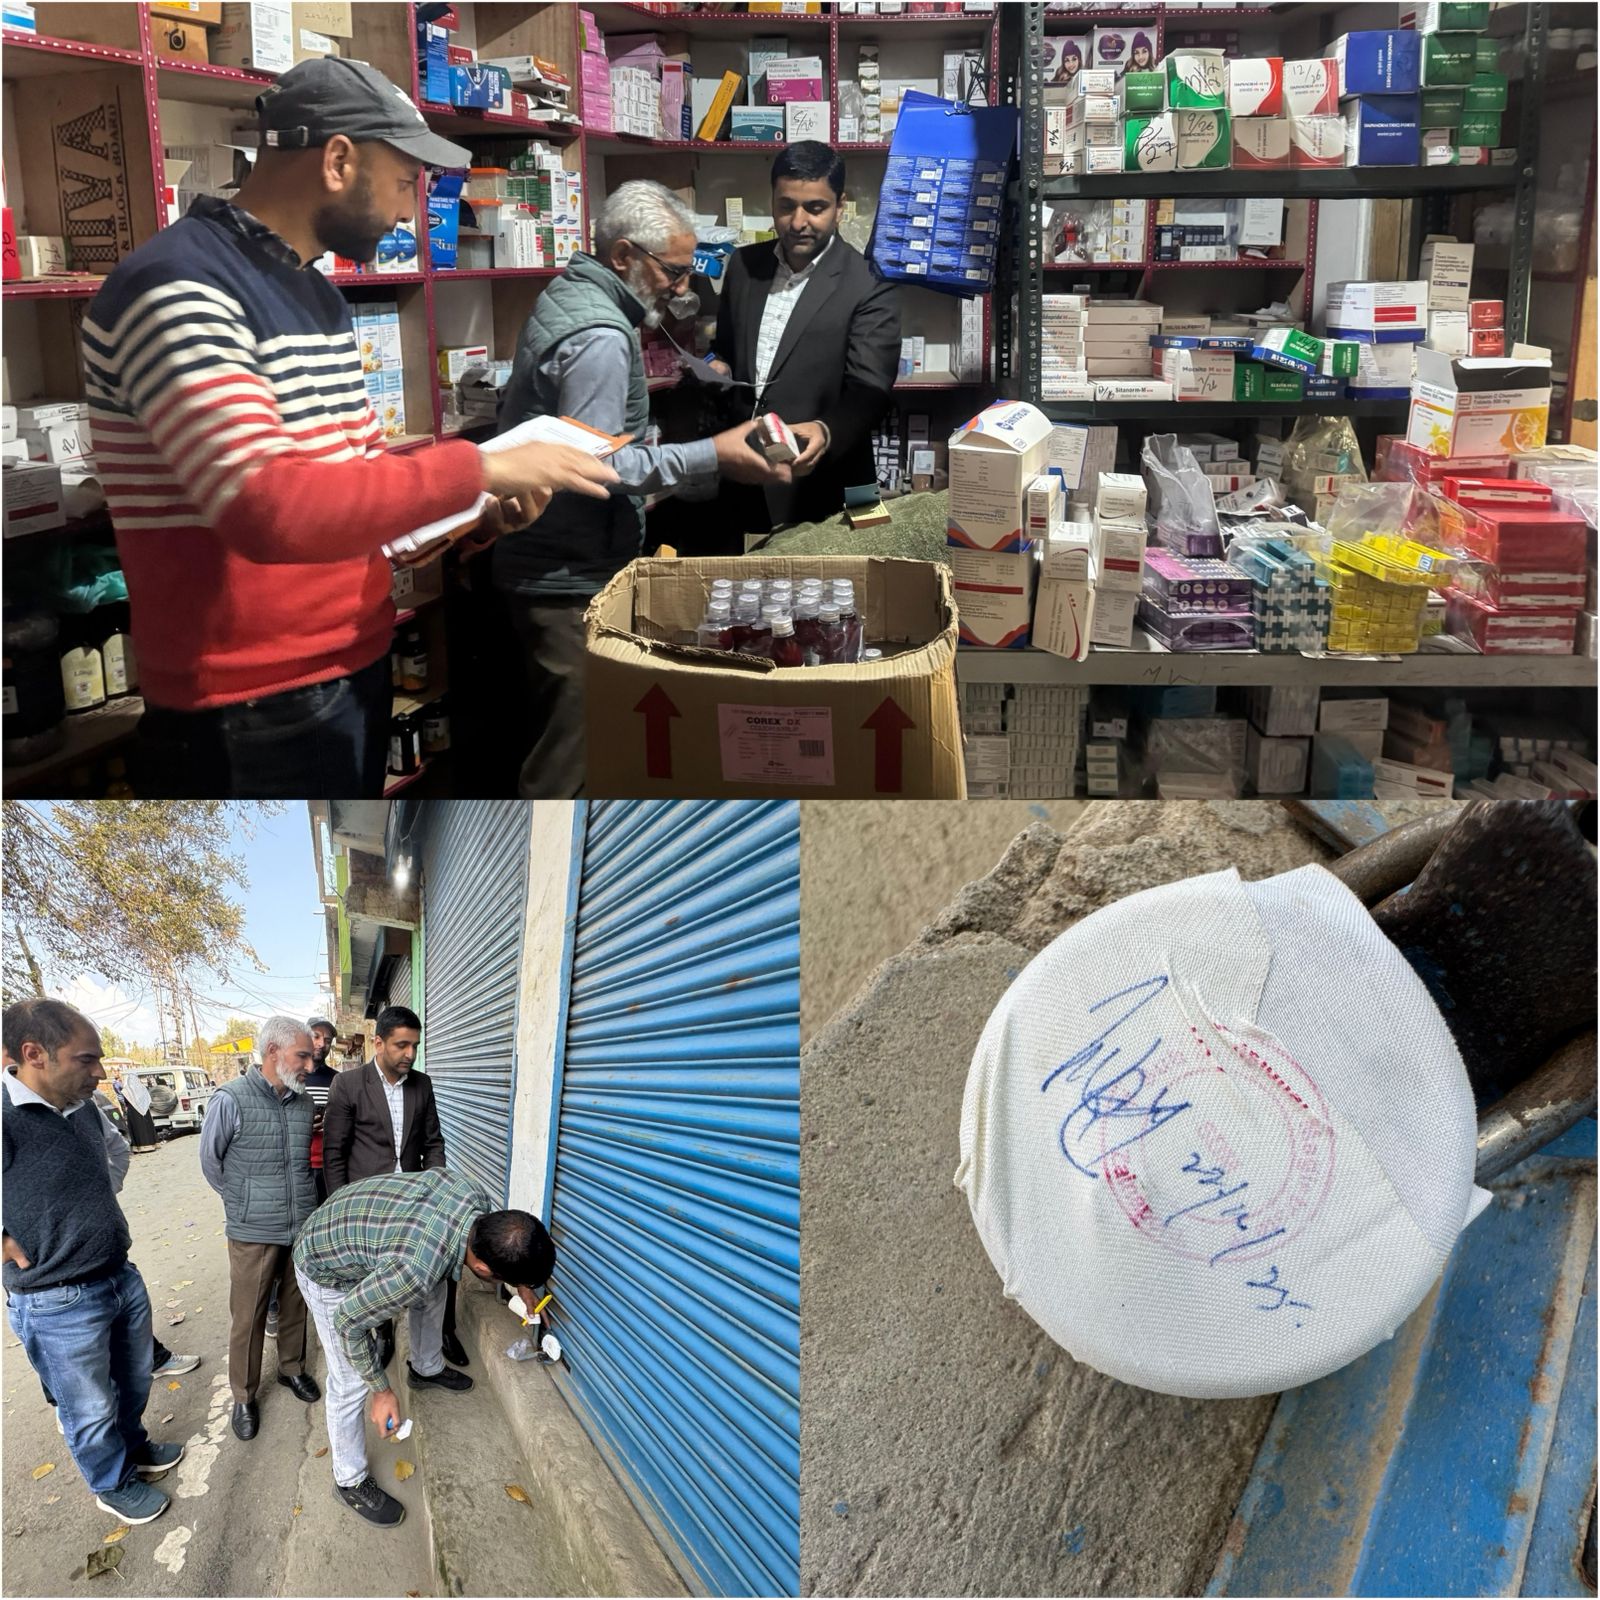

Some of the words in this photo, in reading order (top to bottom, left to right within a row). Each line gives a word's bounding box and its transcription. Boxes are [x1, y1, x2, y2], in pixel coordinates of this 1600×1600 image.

[108, 104, 122, 166] BOARD
[1187, 112, 1214, 133] 9/26
[116, 173, 129, 232] BLOCK
[746, 716, 781, 726] COREX
